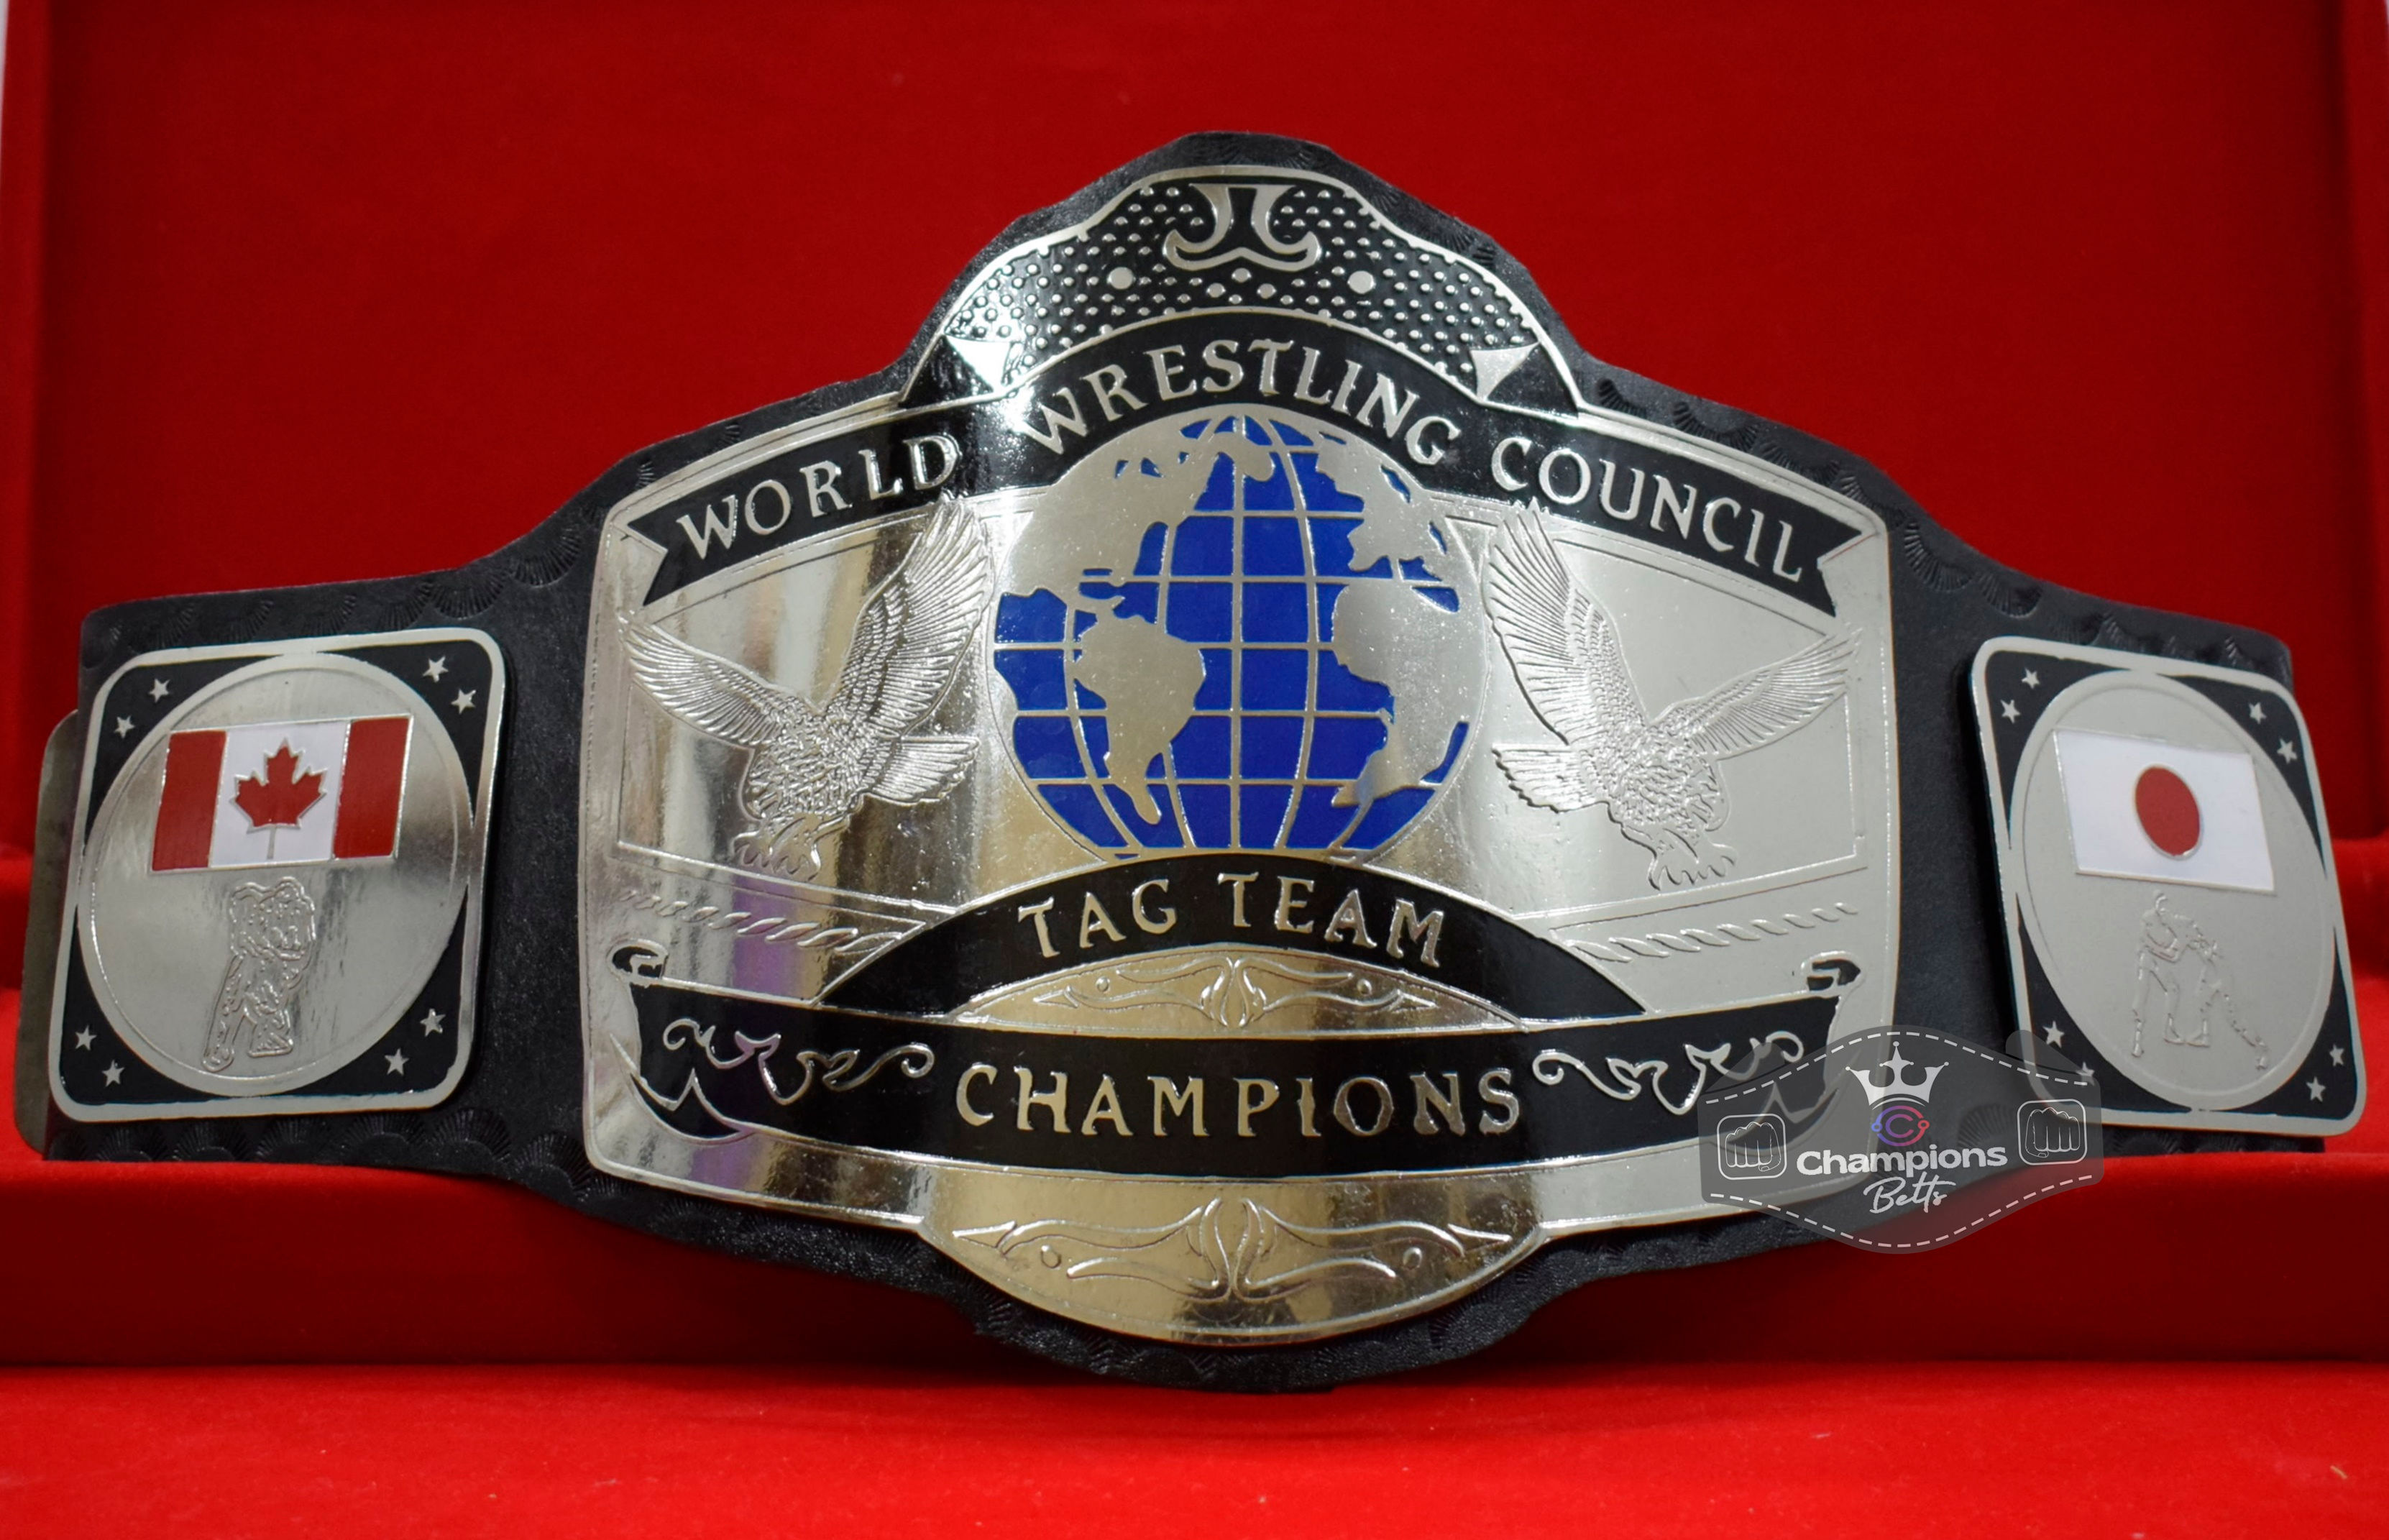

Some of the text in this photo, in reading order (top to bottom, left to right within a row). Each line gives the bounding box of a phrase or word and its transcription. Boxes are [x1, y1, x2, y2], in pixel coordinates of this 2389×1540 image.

[677, 339, 1802, 582] WORLD WRESTLING COUNCIL
[1017, 871, 1444, 968] TAG TEAM
[955, 1063, 1520, 1138] CHAMPIONS
